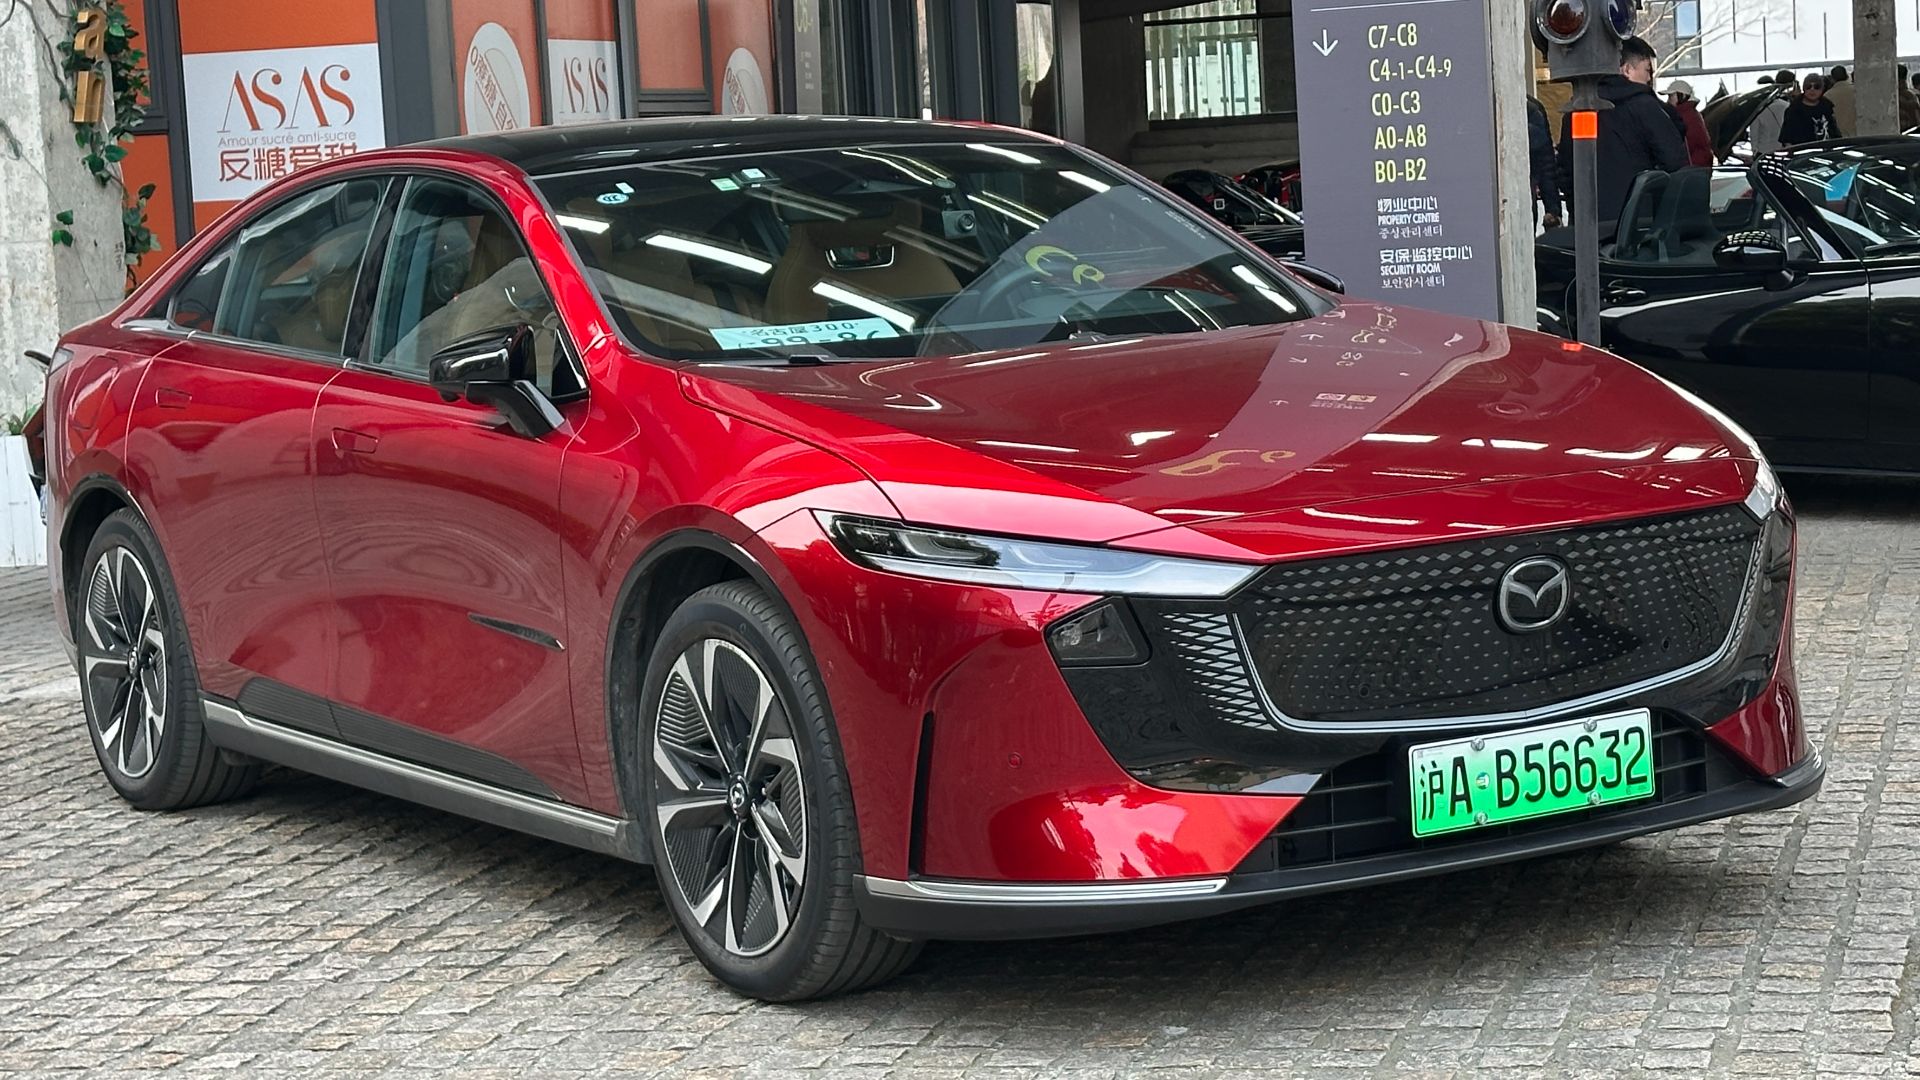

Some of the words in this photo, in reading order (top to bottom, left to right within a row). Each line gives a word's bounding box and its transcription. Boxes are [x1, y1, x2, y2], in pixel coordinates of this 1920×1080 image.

[1368, 23, 1417, 49] C7-C8
[559, 57, 609, 113] ASAS
[217, 64, 355, 133] ASAS
[1371, 90, 1421, 116] C0-C3
[217, 136, 258, 148] Amour
[1374, 124, 1427, 150] A0-A8
[1375, 158, 1427, 183] B0-B2
[1377, 196, 1438, 213] 物业中心
[1377, 213, 1412, 226] PROPERTY
[1412, 212, 1440, 224] CENTRE
[1380, 264, 1415, 276] SECURITY
[1416, 262, 1441, 273] ROOM
